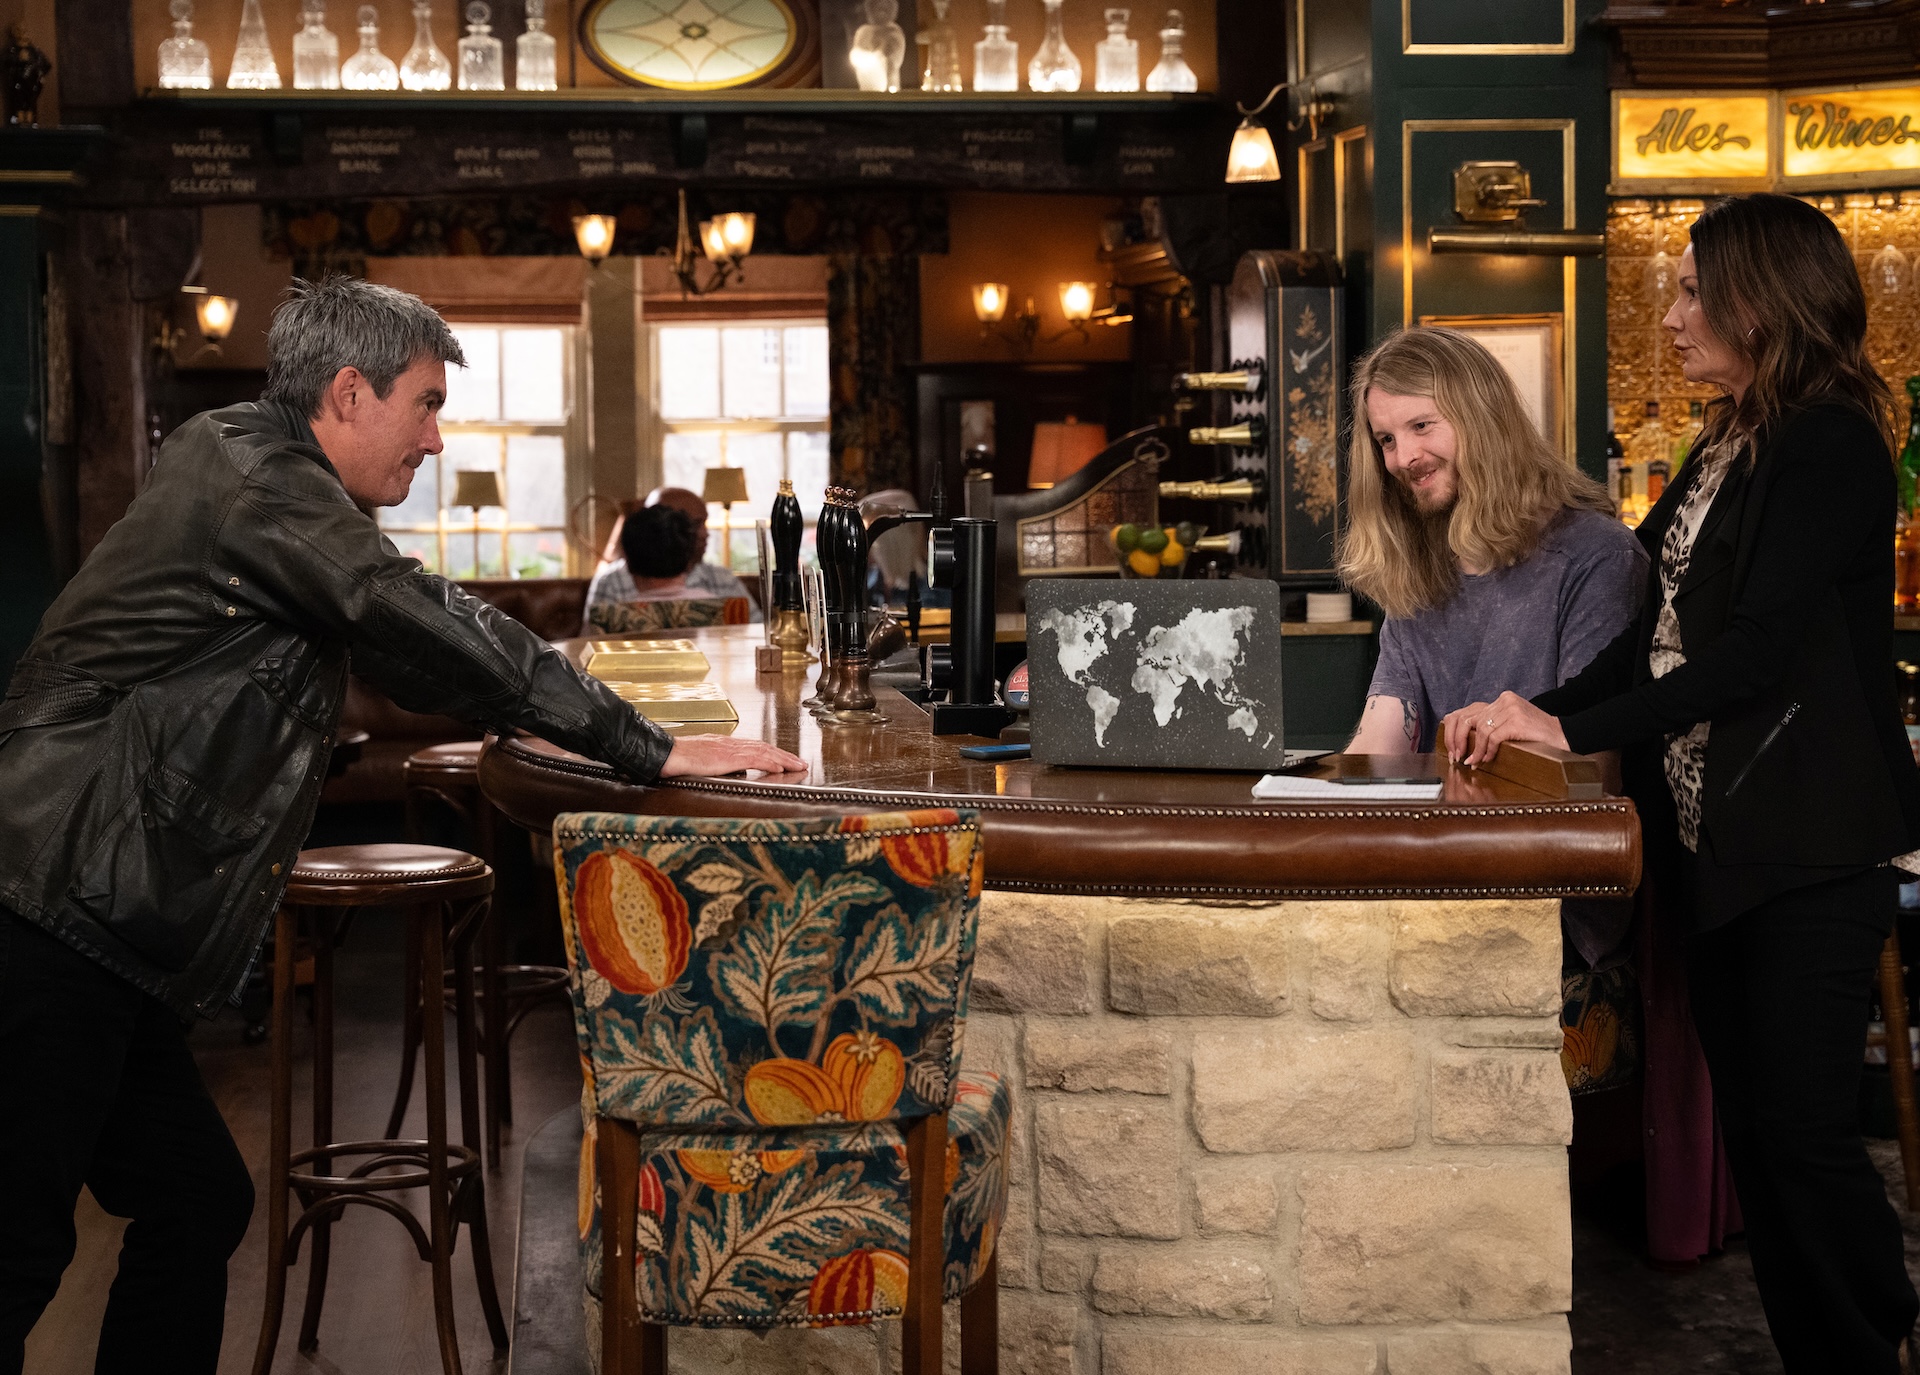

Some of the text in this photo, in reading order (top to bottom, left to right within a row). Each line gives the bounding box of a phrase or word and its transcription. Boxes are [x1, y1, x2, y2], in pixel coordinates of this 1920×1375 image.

[1637, 107, 1750, 156] Ales
[1790, 101, 1920, 150] Wines
[172, 143, 250, 158] WOOLPACK
[170, 178, 257, 193] SELECTION
